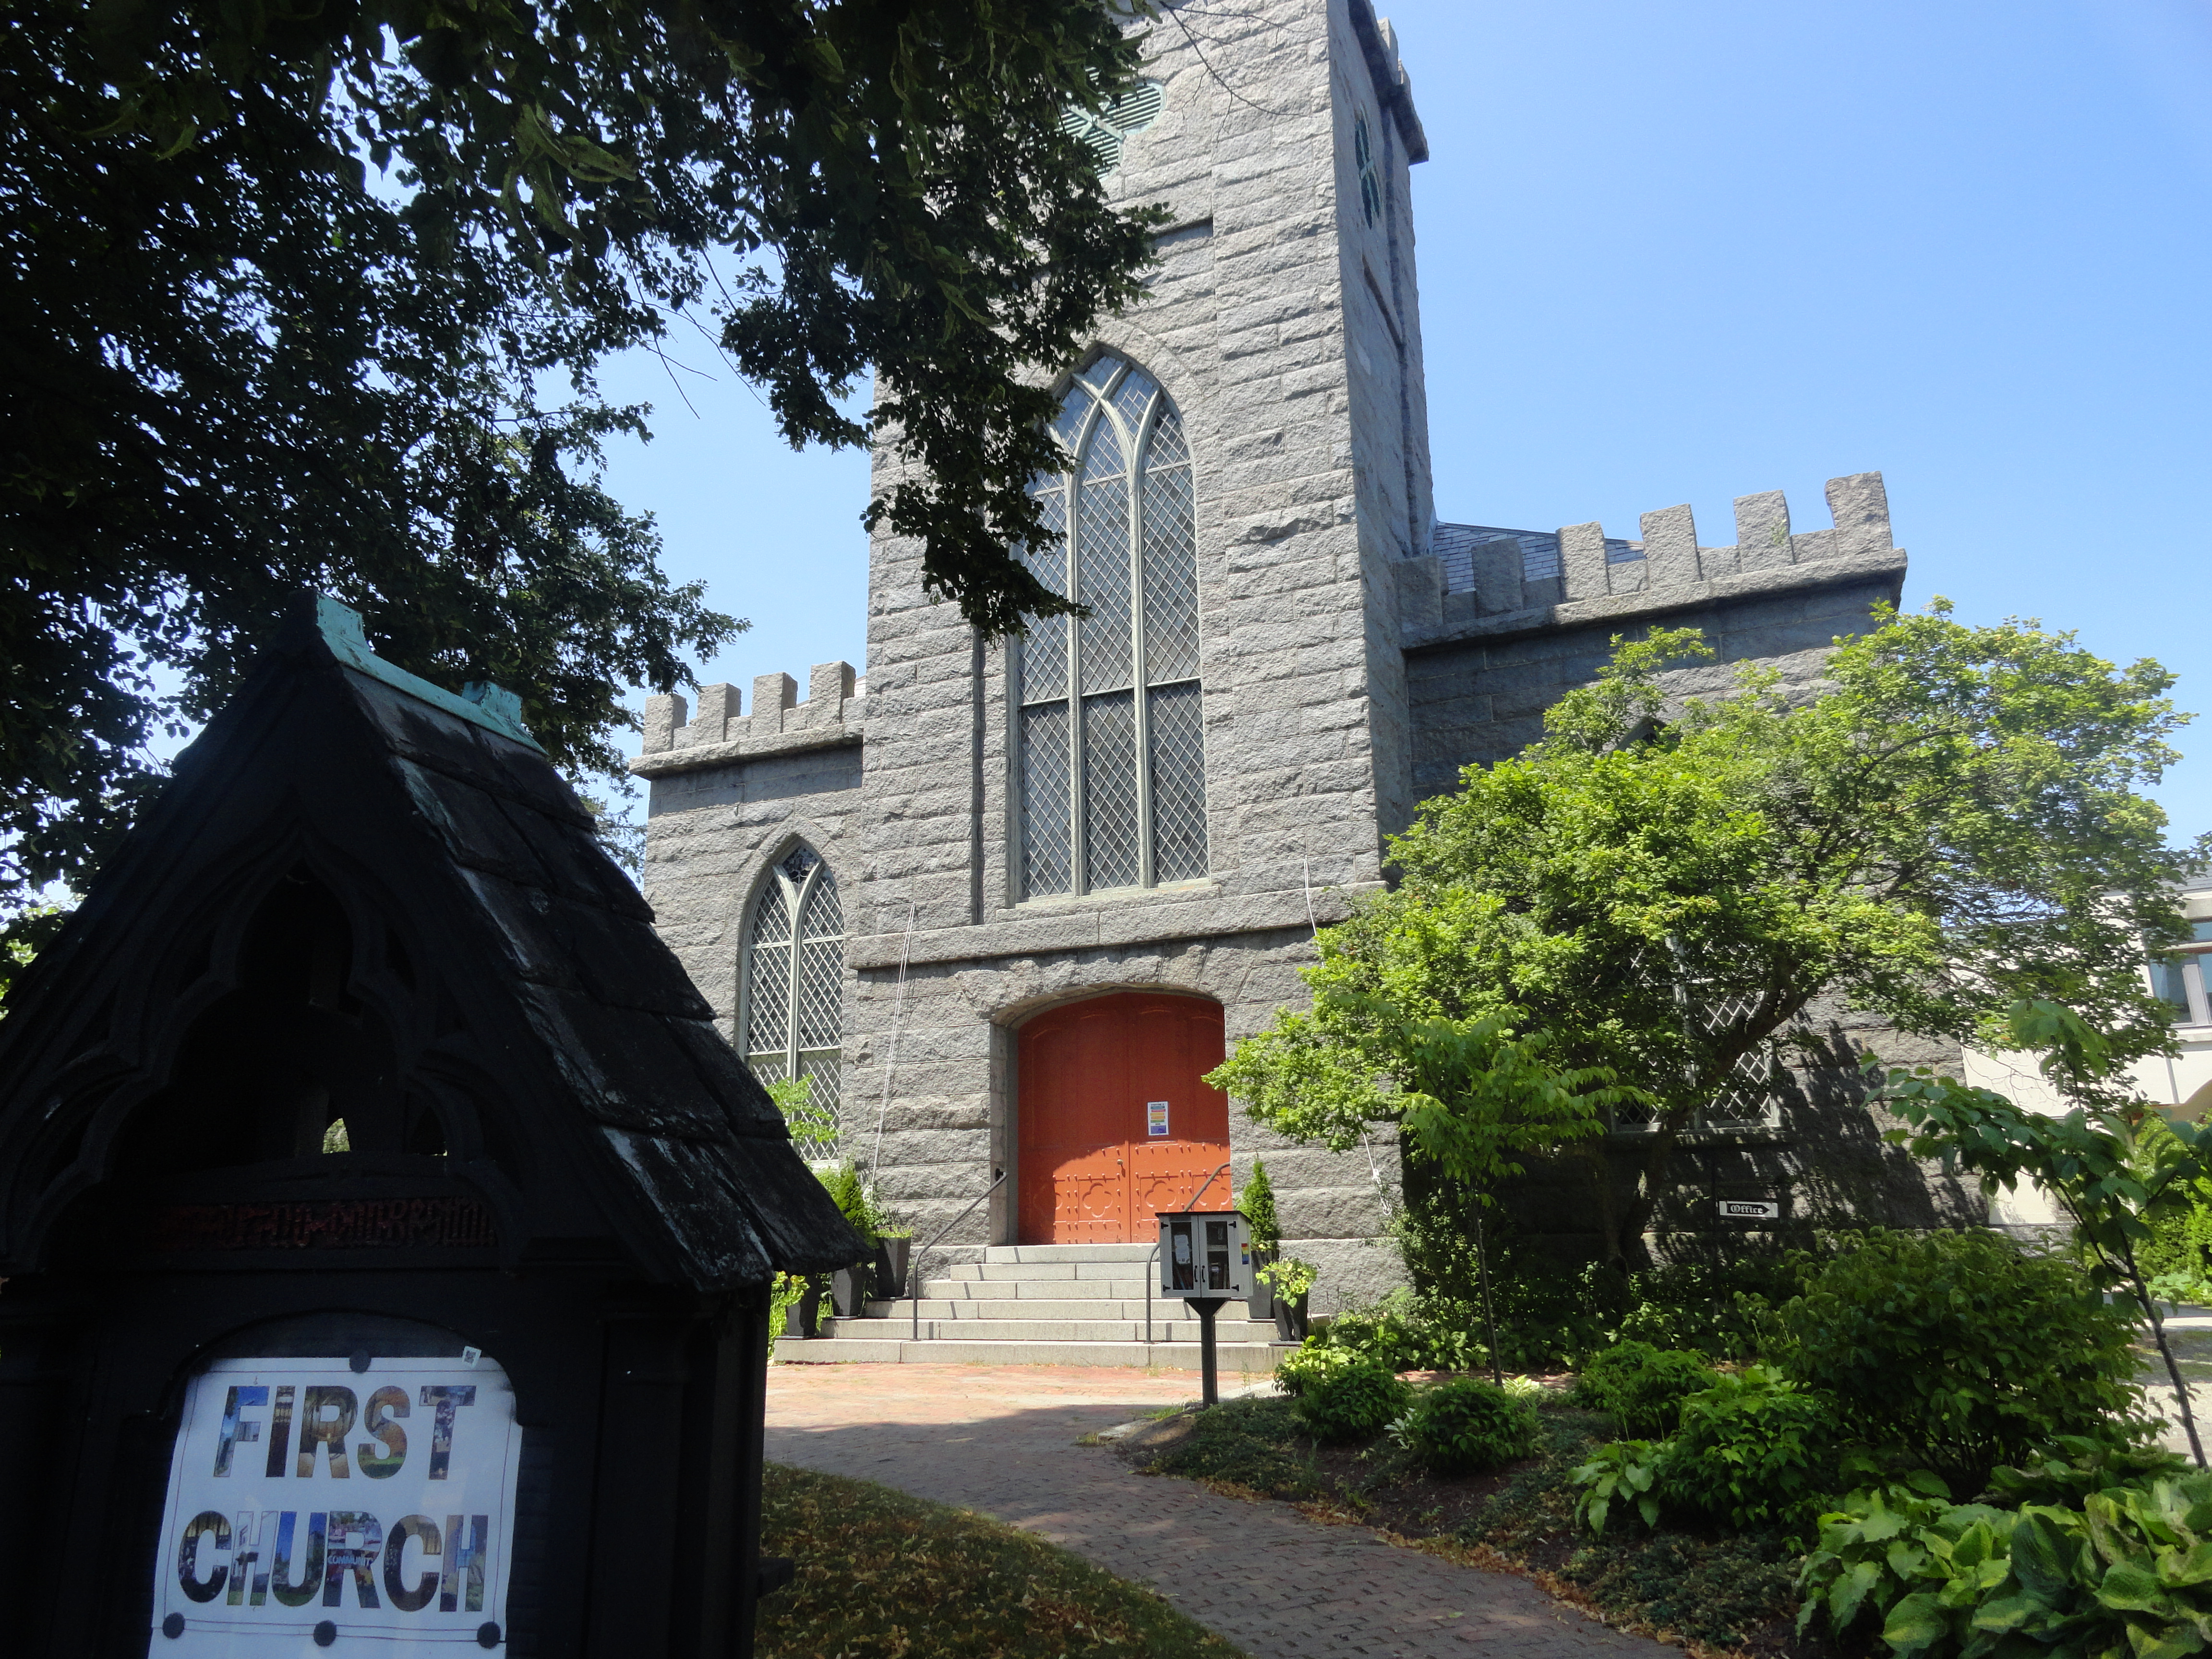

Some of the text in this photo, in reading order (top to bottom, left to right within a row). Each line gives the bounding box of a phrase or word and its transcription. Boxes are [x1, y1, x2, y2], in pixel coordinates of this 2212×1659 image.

[1730, 1204, 1763, 1214] Office
[214, 1385, 477, 1480] FIRST
[178, 1510, 488, 1612] CHURCH
